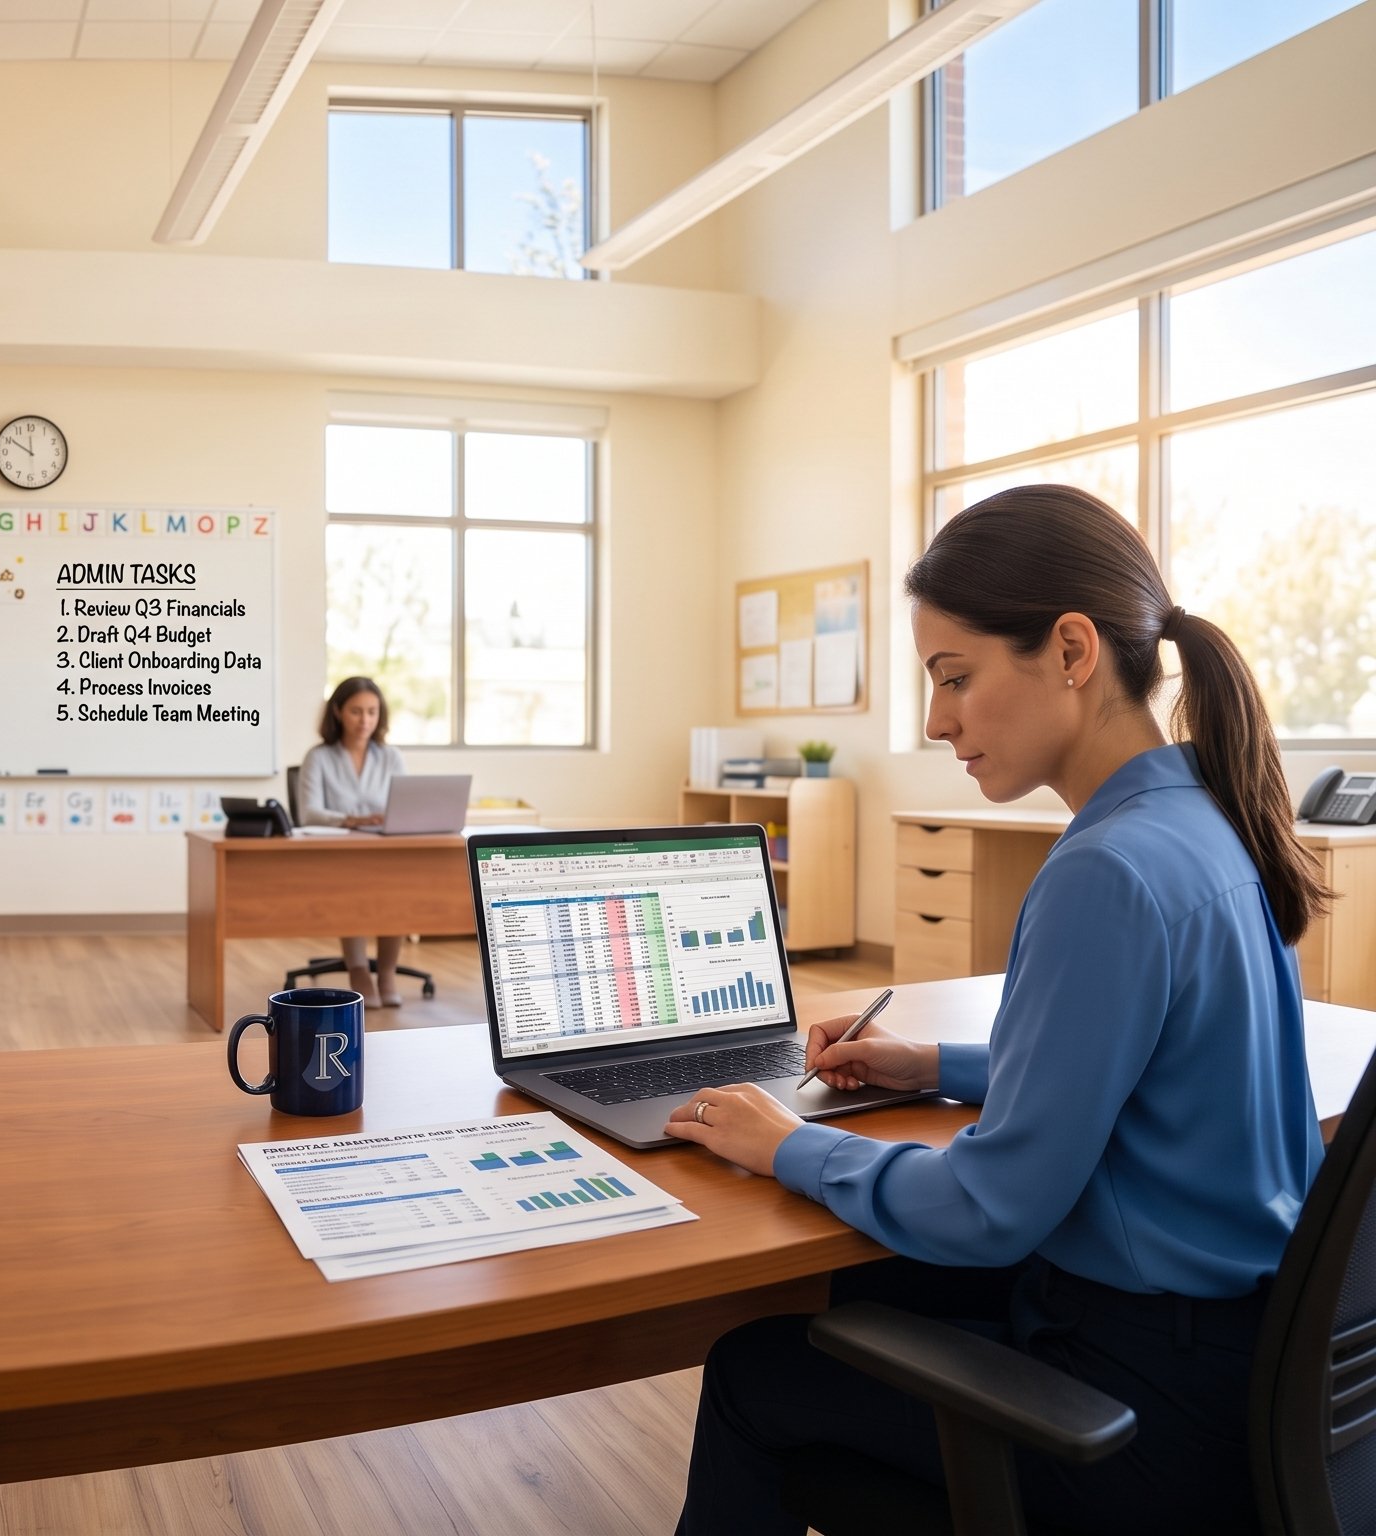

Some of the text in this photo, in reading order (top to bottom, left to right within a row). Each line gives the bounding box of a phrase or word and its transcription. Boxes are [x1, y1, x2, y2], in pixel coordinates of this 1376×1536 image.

[27, 513, 42, 531] H
[58, 513, 69, 531] I
[83, 513, 99, 531] J
[113, 513, 128, 532] K
[141, 514, 154, 532] L
[167, 515, 187, 533] M
[196, 516, 215, 534] O
[227, 516, 241, 534] P
[254, 517, 269, 536] Z
[57, 563, 197, 585] ADMIN TASKS
[61, 598, 246, 619] 1. Review Q3 Financials
[57, 625, 212, 648] 2. Draft Q4 Budget
[56, 651, 262, 674] 3. Client Onboarding Data
[56, 677, 212, 696] 4. Process Invoices
[56, 703, 260, 727] 5. Schedule Team Meeting
[315, 1033, 351, 1080] R
